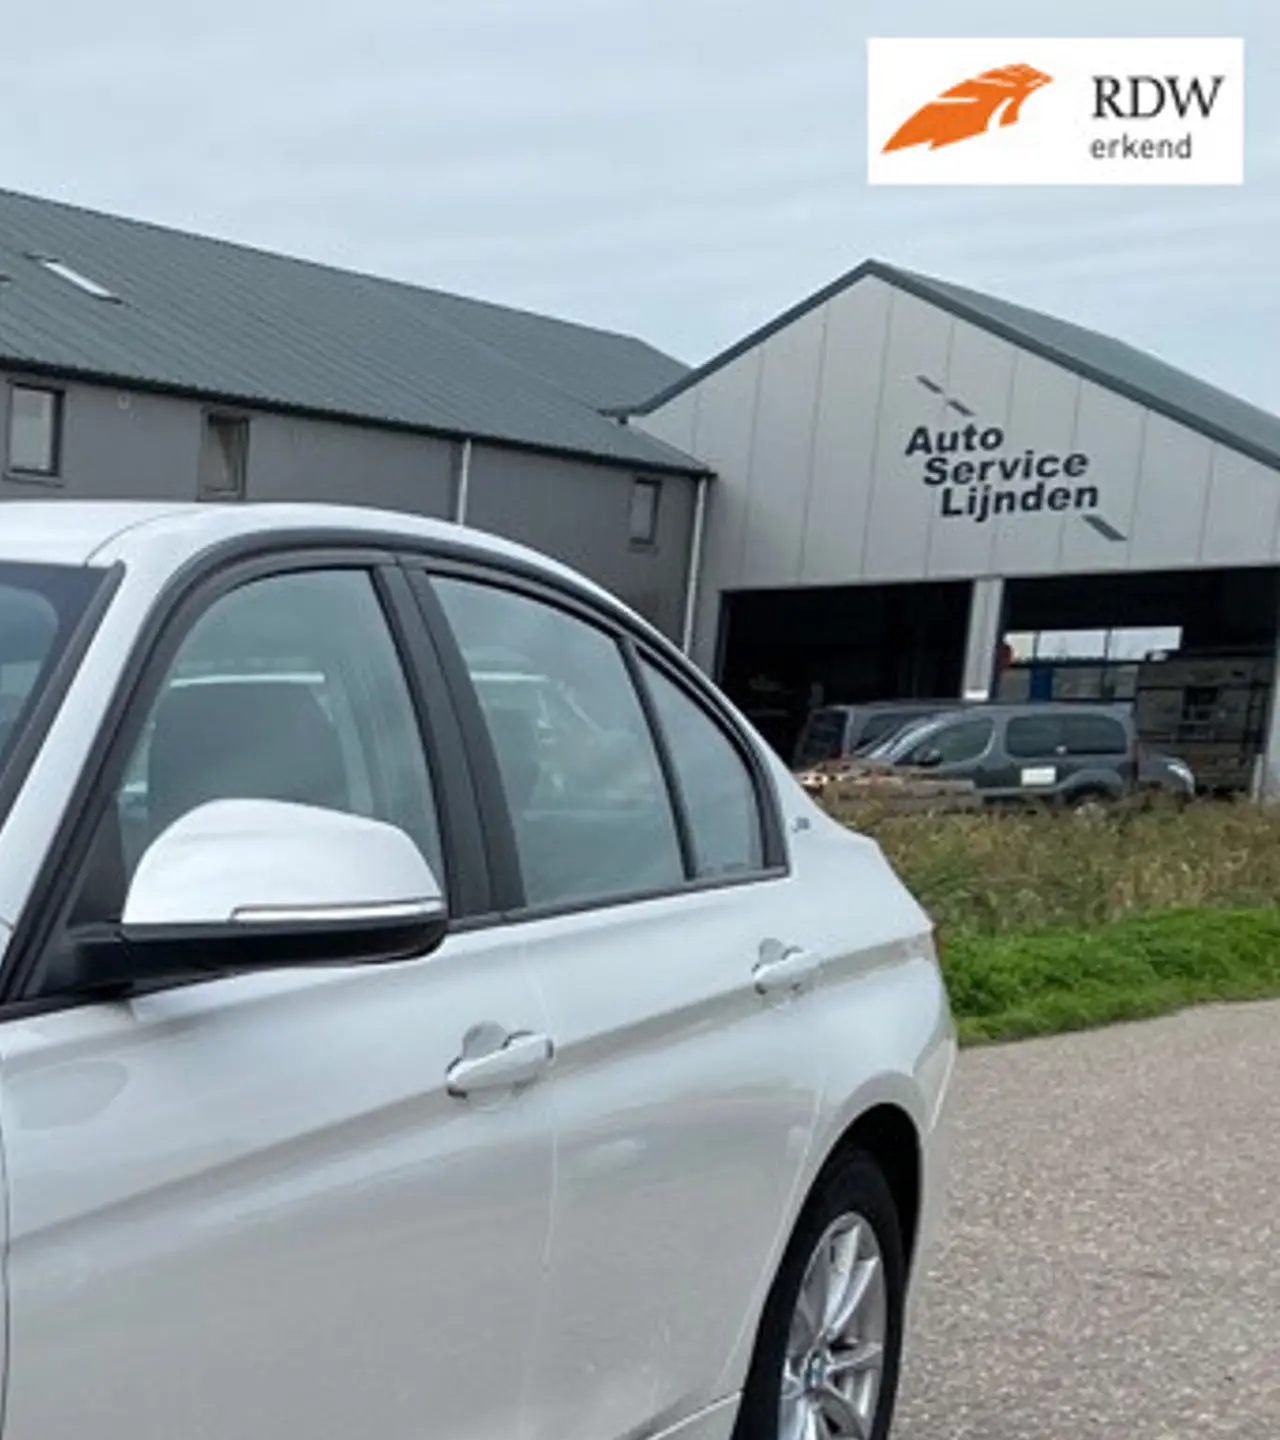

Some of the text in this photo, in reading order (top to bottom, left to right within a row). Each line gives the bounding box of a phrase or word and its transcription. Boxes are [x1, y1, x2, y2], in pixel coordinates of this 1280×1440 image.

[905, 423, 1004, 456] Auto
[923, 449, 1089, 486] Service
[941, 481, 1099, 522] Lijnden
